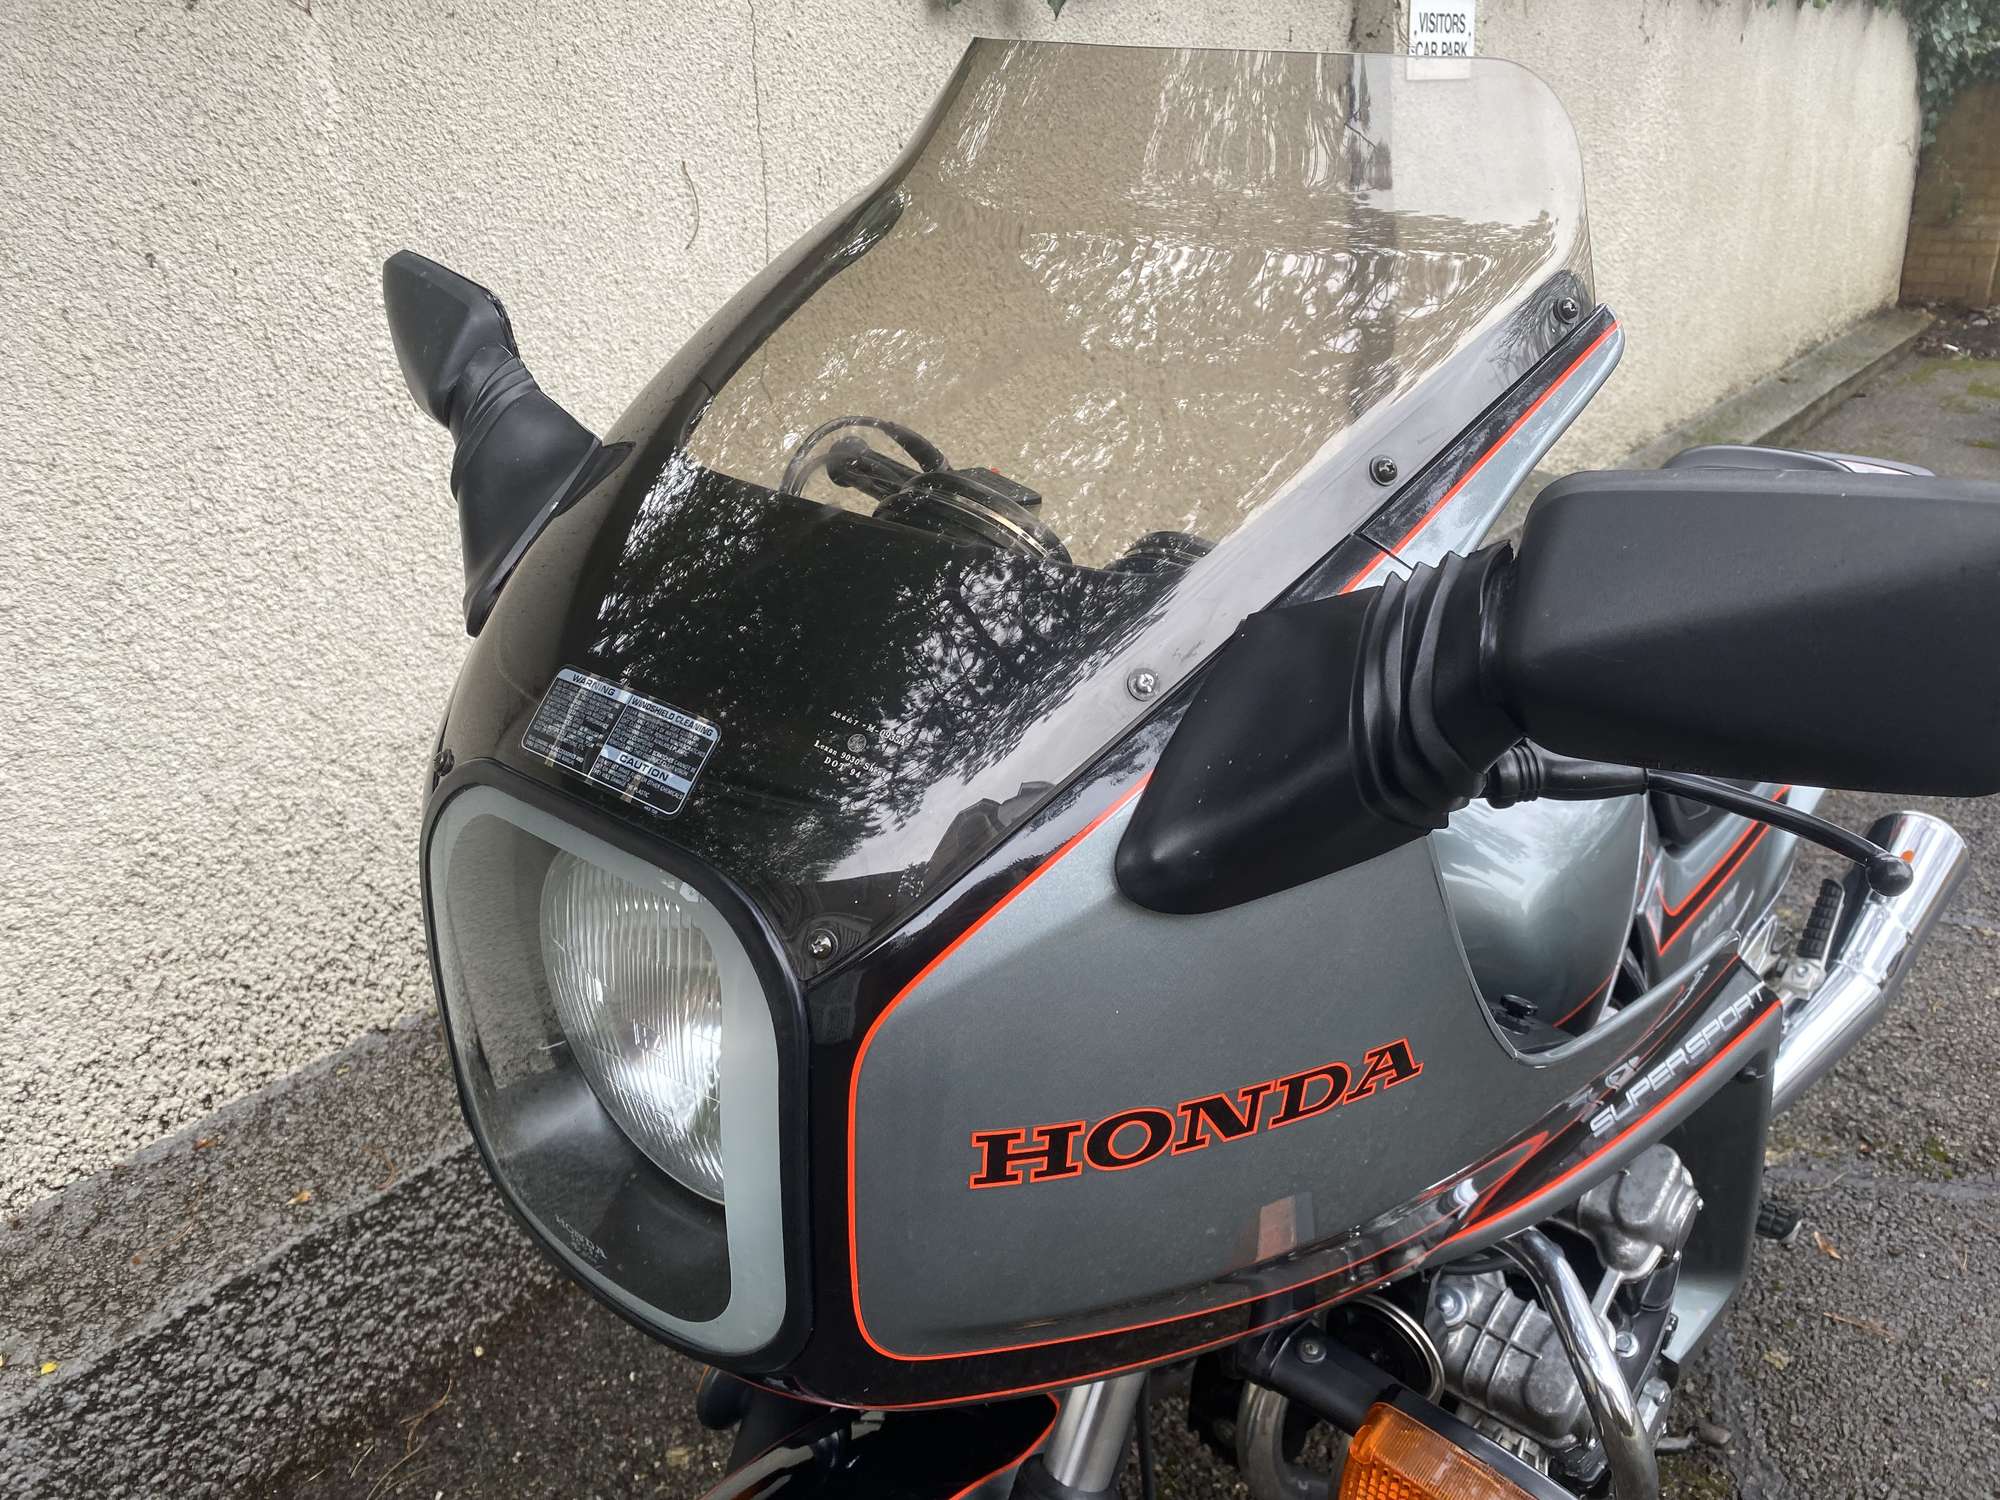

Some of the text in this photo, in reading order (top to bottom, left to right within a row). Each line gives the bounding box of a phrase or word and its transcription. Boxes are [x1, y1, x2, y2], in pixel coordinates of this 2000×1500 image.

[1419, 12, 1466, 34] VISITORS
[1415, 42, 1468, 56] CAR PARK
[572, 674, 616, 697] WARNING
[631, 696, 674, 721] WINDSHIELD
[675, 715, 714, 737] CLEANING
[814, 739, 838, 756] Lexan
[619, 755, 669, 782] CAUTION
[824, 756, 862, 778] DOT 94
[968, 1037, 1424, 1189] HONDA
